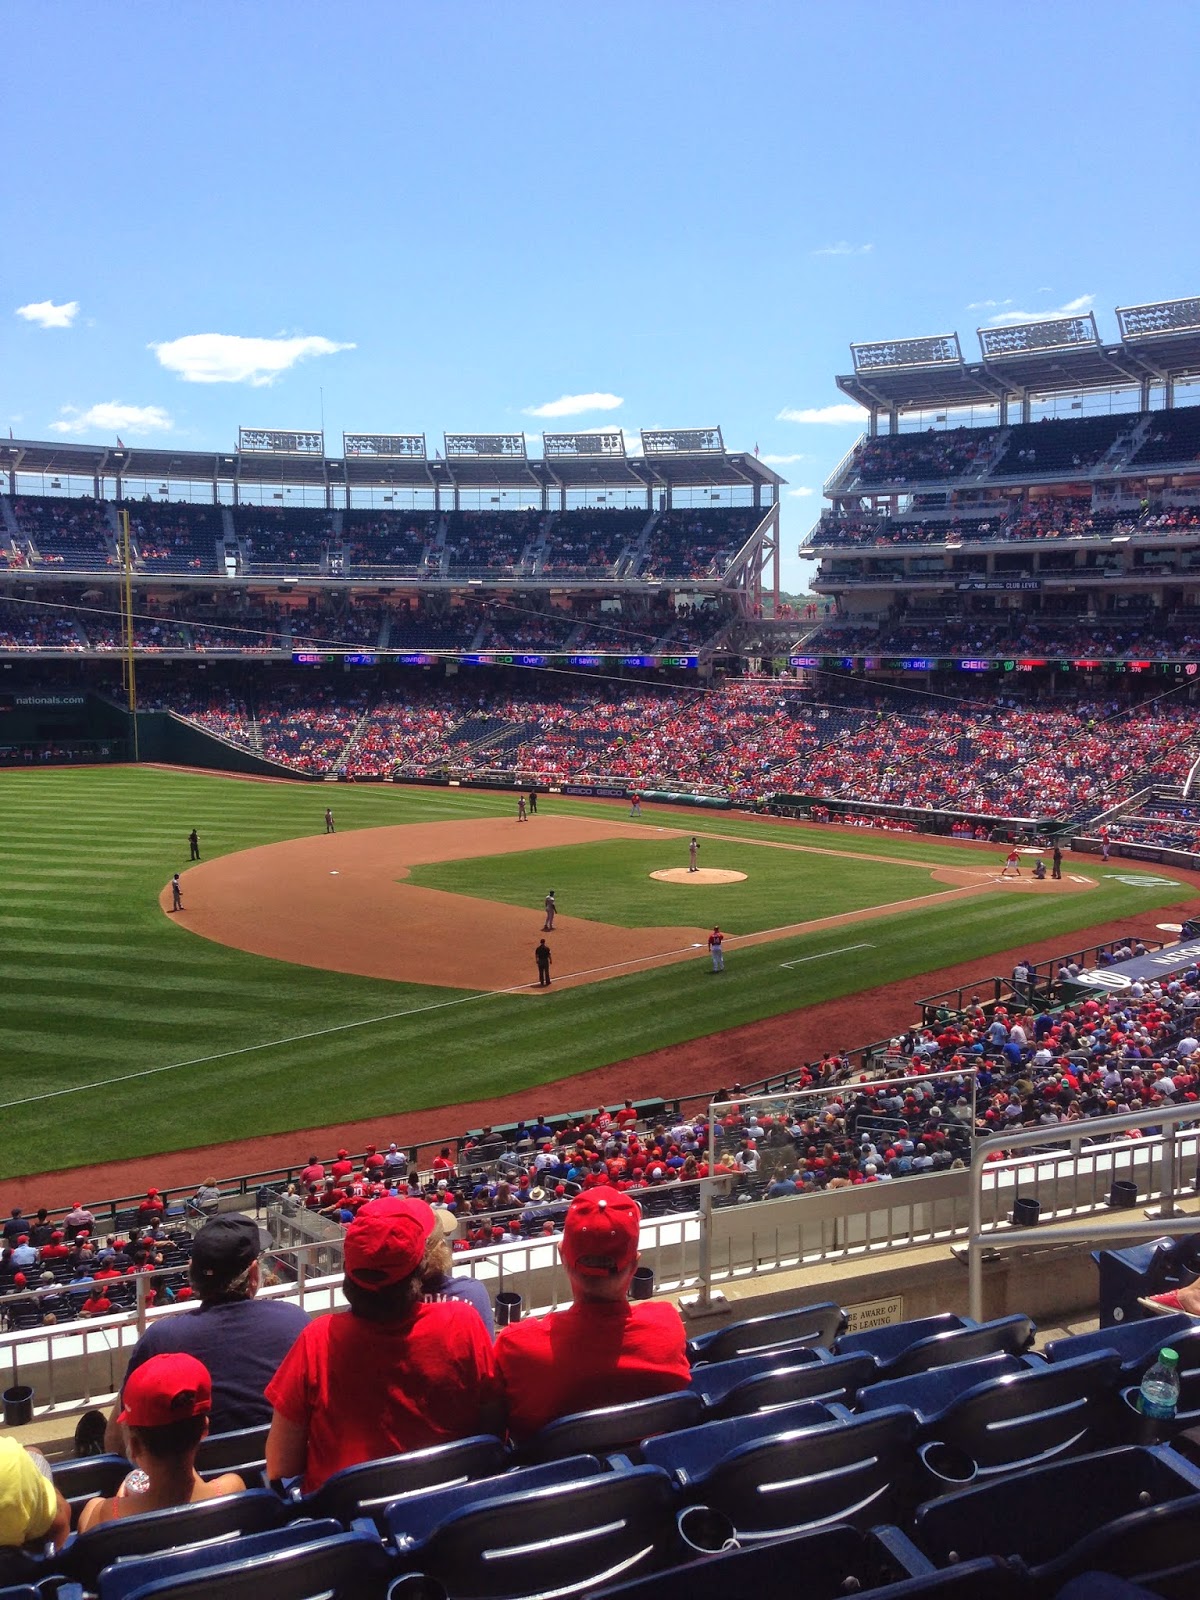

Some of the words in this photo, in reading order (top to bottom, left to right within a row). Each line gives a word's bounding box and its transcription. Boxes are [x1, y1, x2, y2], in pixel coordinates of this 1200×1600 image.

[961, 661, 1000, 669] GEICO
[16, 696, 84, 704] nationals.com
[860, 1307, 886, 1319] AWARE
[888, 1305, 898, 1313] OF
[860, 1316, 891, 1330] LEAVING
